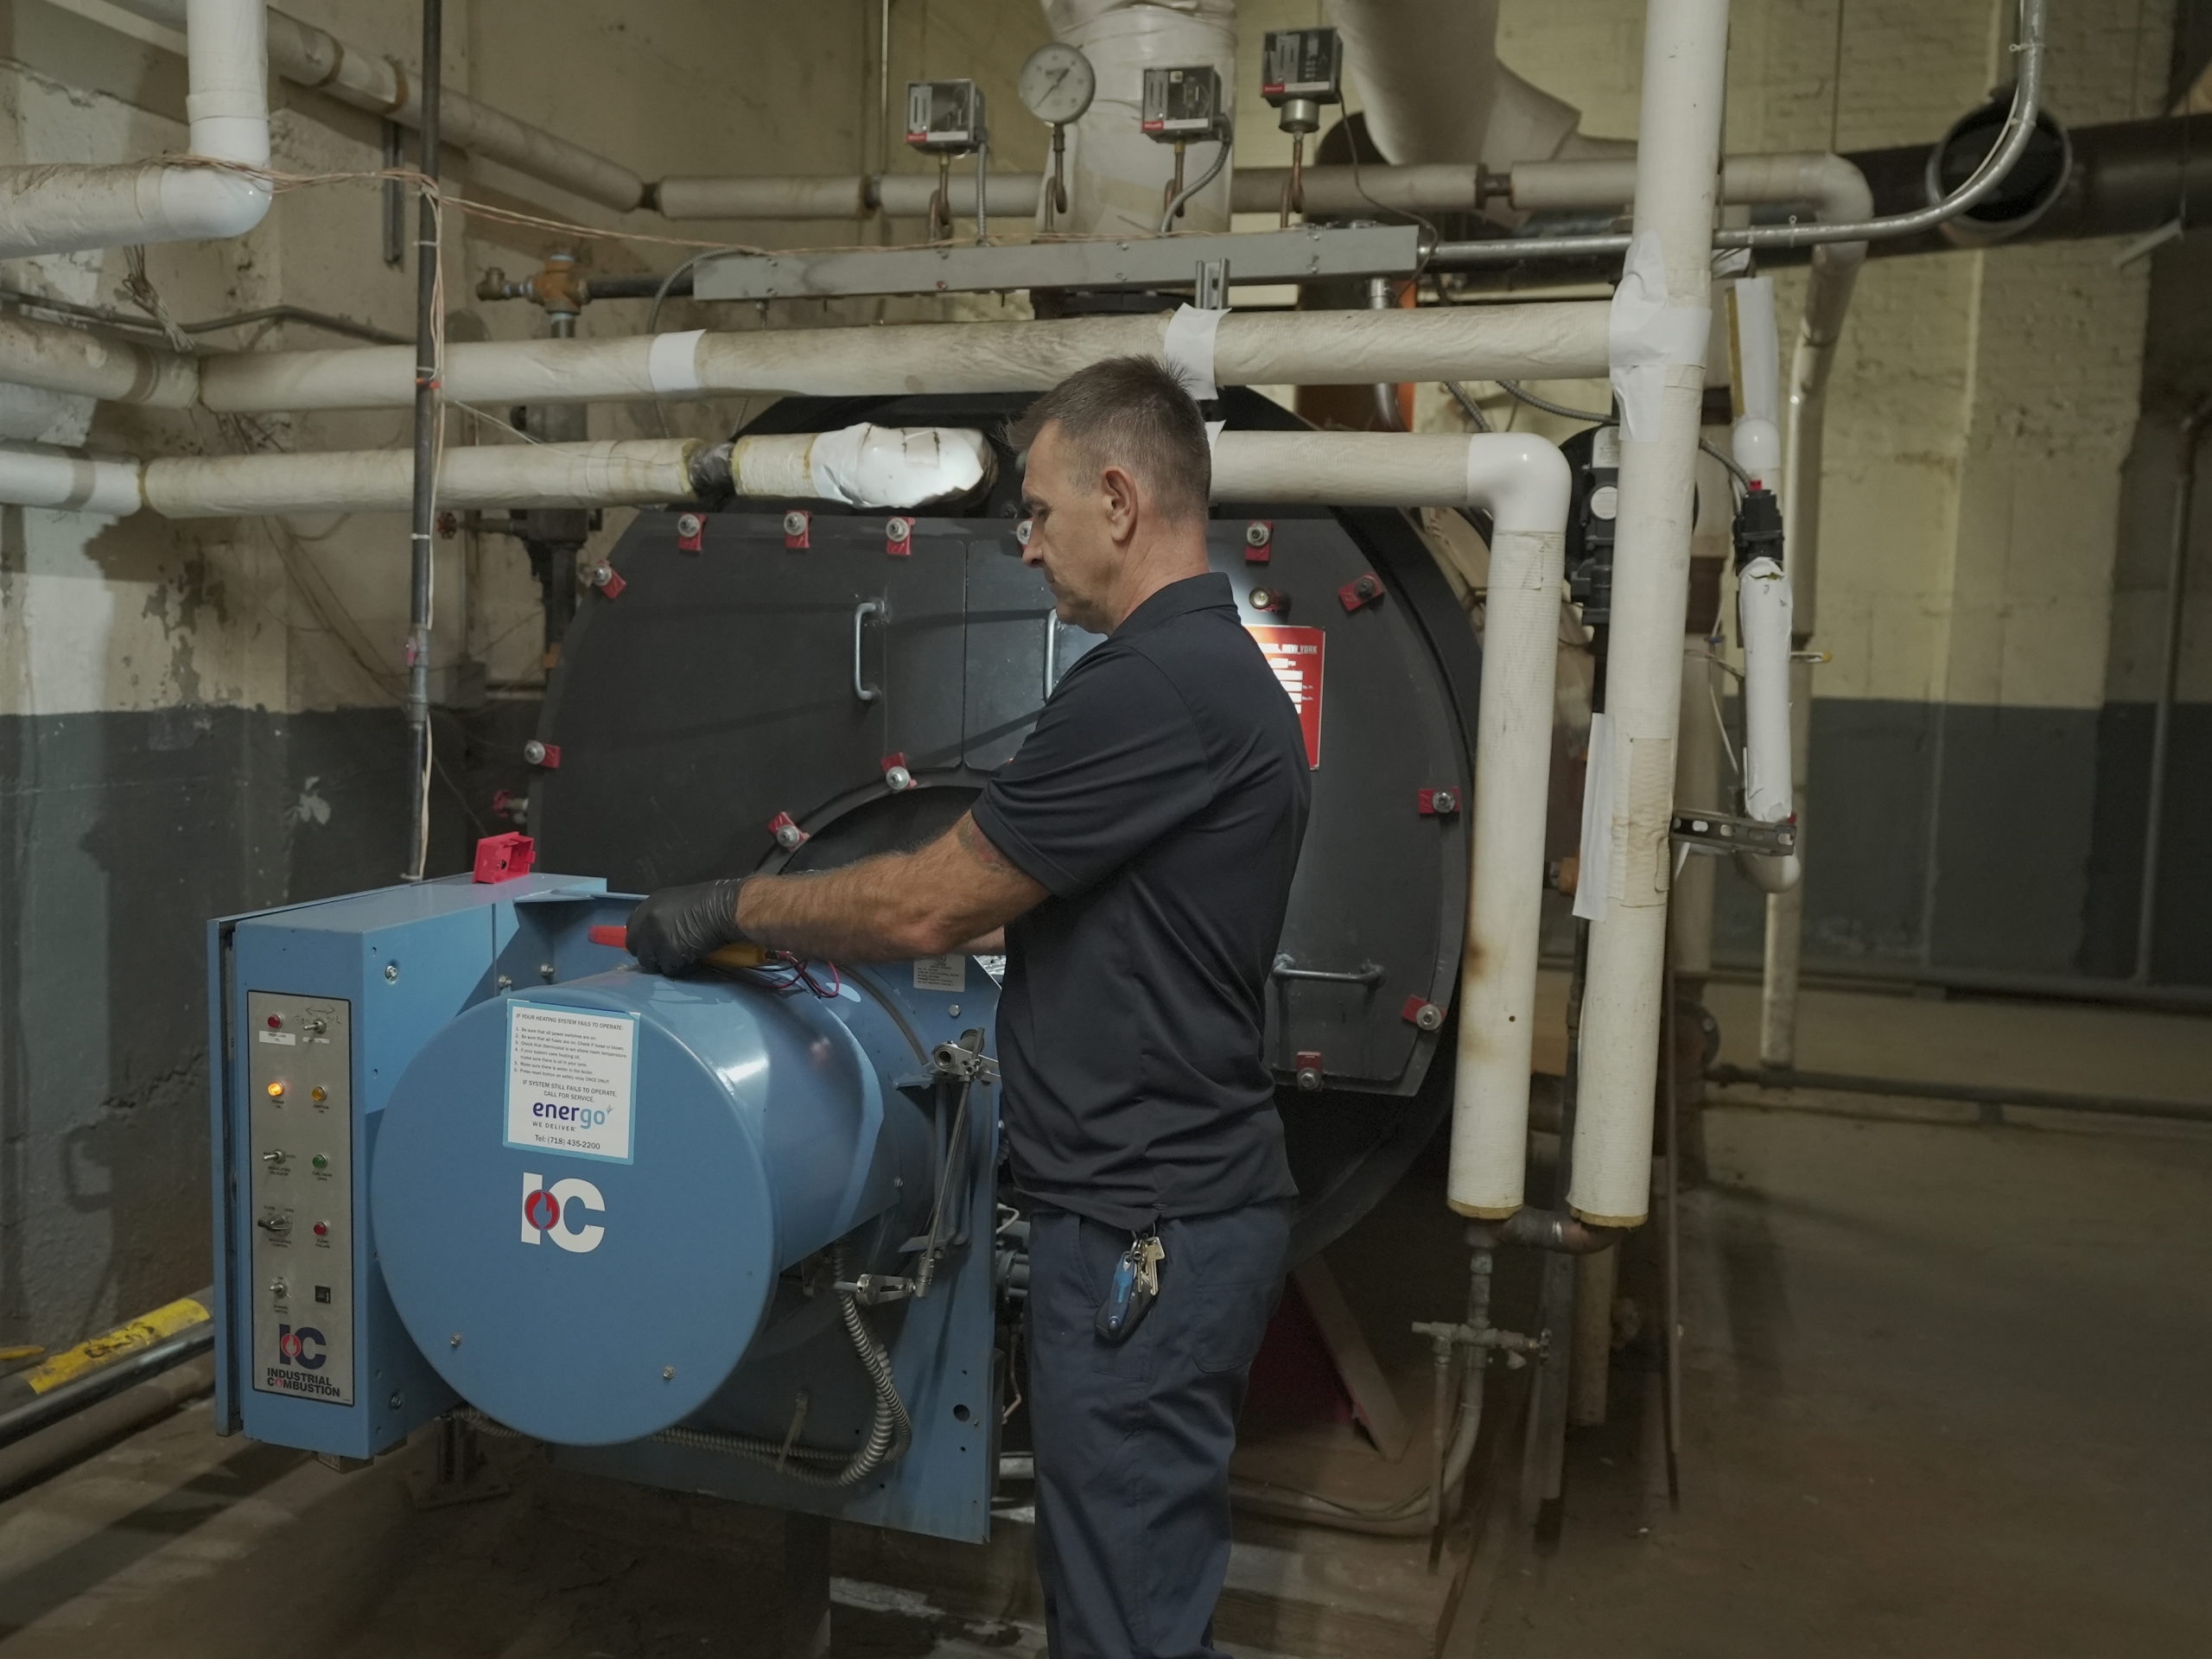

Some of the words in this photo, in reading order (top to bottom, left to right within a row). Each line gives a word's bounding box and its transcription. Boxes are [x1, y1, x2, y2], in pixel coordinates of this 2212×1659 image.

[1300, 645, 1317, 653] YORK
[571, 1094, 594, 1102] SERVICE.
[591, 1088, 617, 1097] OPERATE,
[533, 1102, 605, 1129] energo
[548, 1137, 565, 1146] (718)
[567, 1140, 600, 1150] 435-2200
[521, 1172, 605, 1253] IC
[279, 1324, 326, 1370] IC
[268, 1368, 332, 1386] INDUSTRIAL
